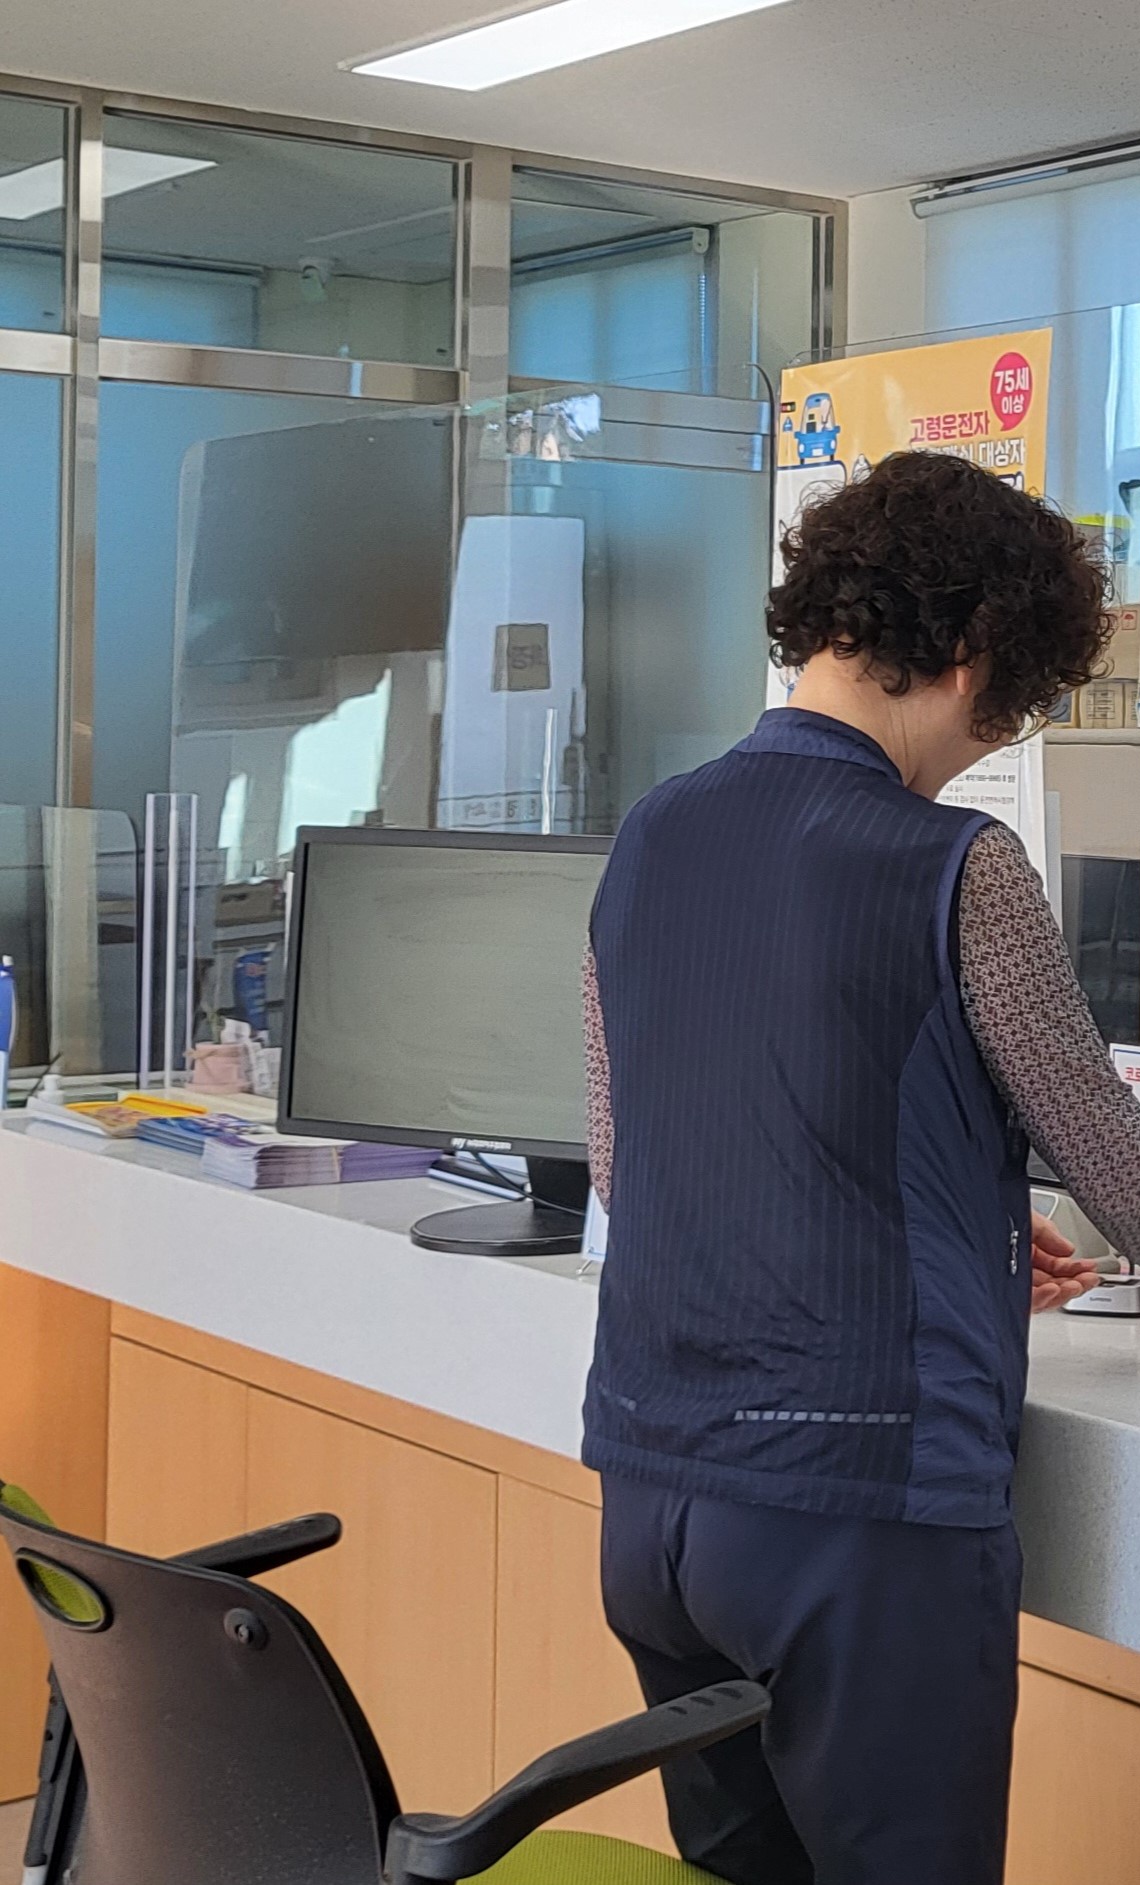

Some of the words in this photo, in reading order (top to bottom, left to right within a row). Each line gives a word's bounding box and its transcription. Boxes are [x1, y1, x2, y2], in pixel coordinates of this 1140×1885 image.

[994, 366, 1030, 395] 75세
[1001, 396, 1024, 415] 이상
[910, 410, 990, 443] 고령운전자
[979, 438, 1025, 468] 대상자
